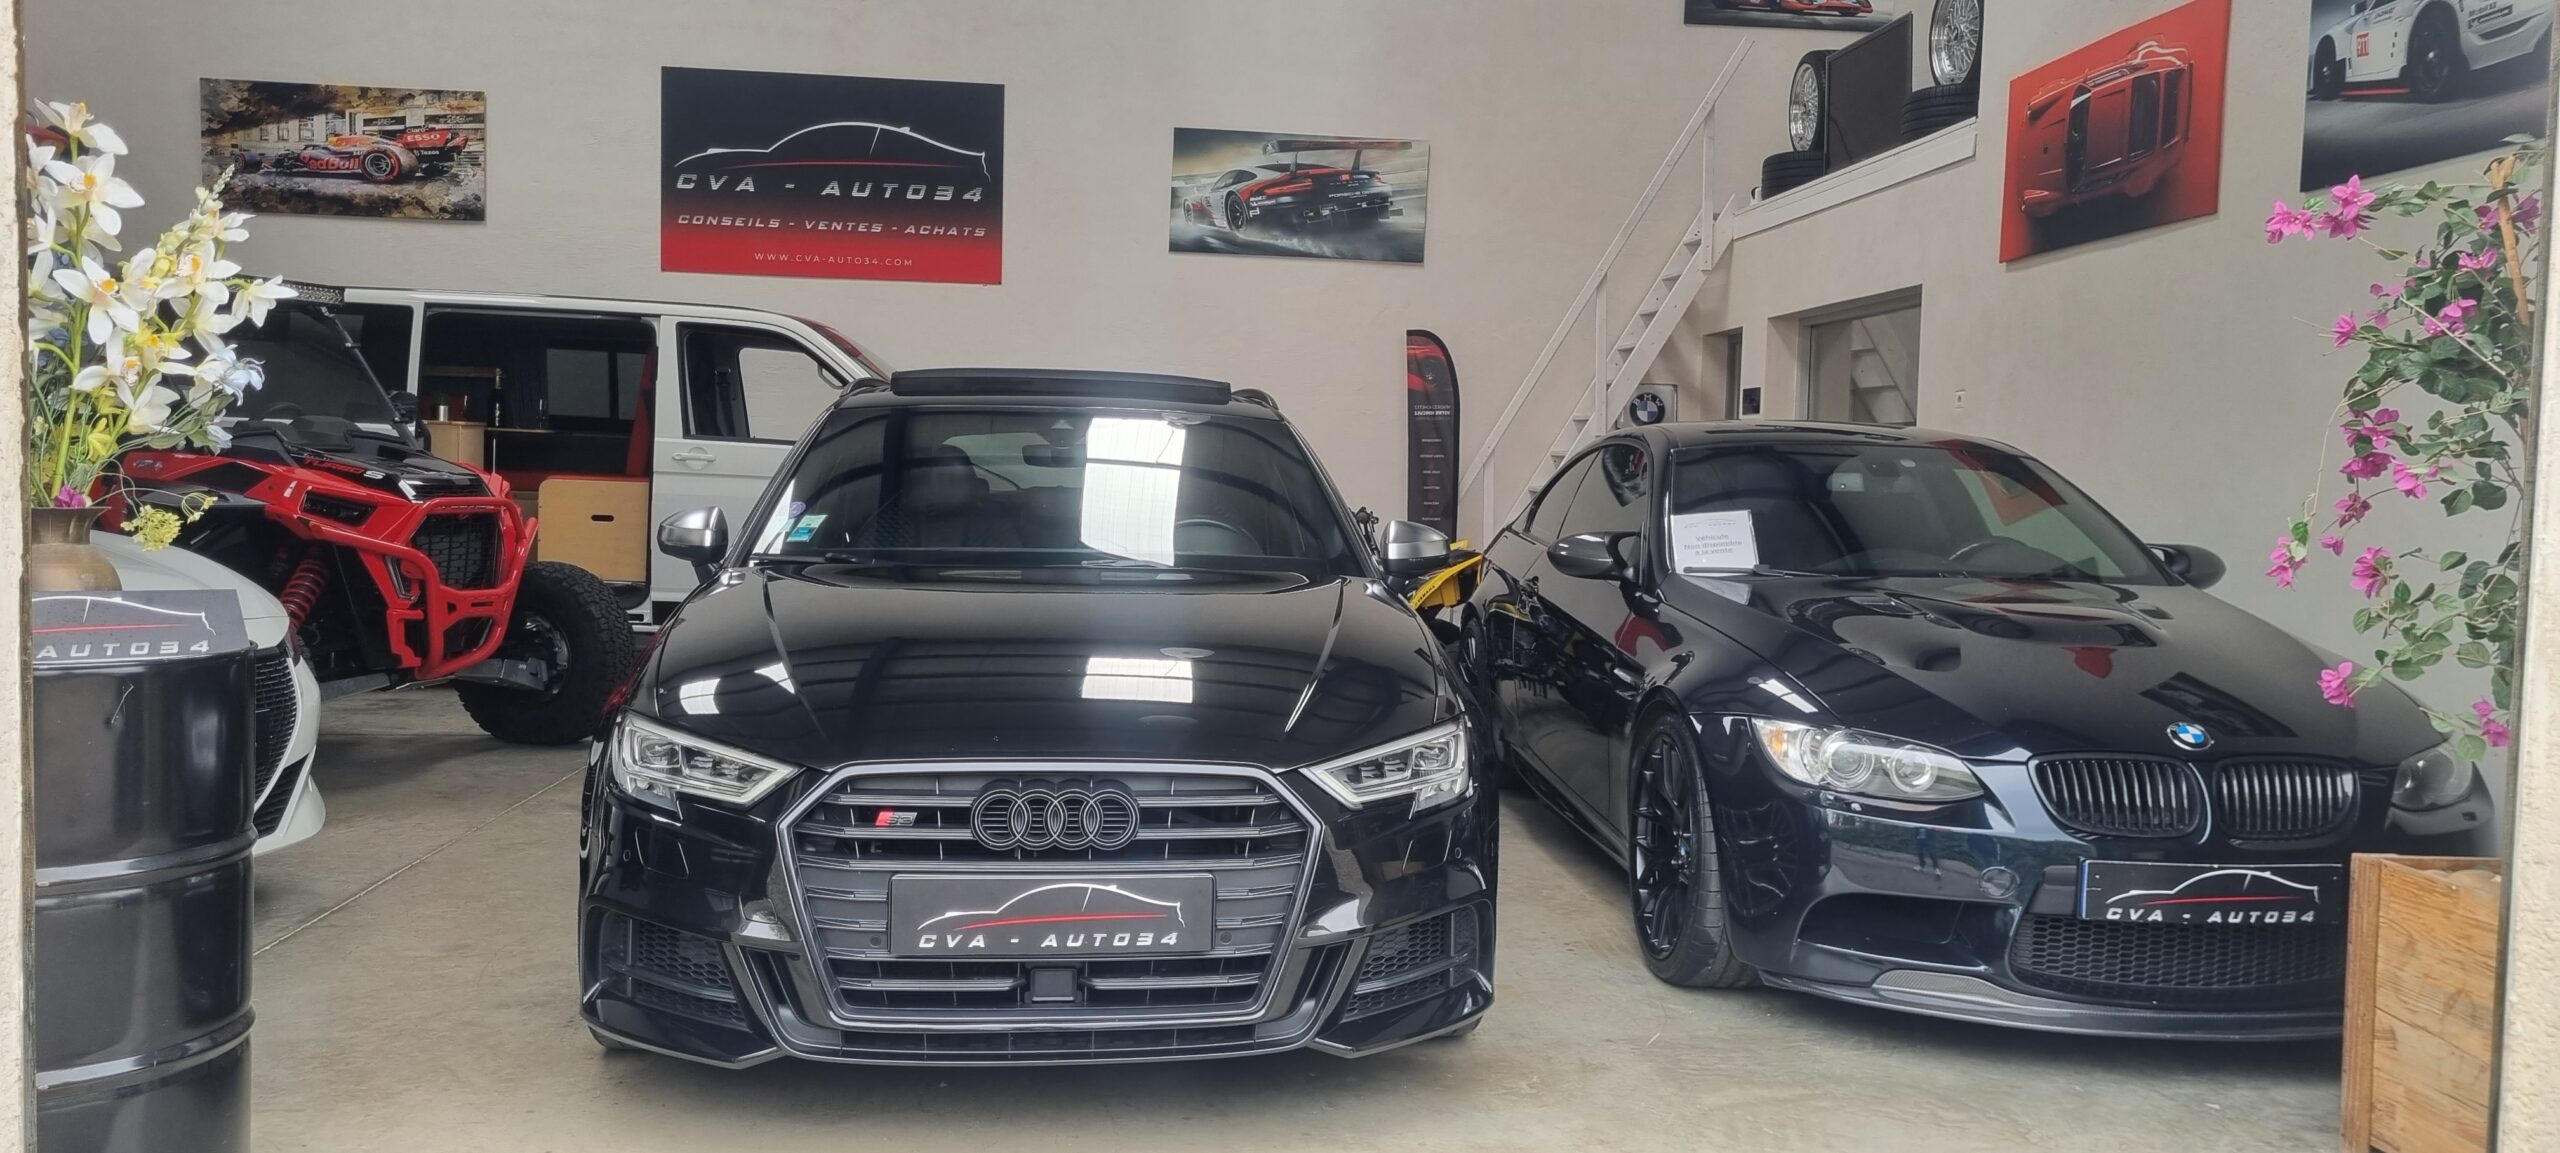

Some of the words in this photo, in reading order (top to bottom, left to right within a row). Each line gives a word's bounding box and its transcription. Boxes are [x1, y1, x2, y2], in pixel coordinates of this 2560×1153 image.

[676, 174, 755, 192] CVA
[821, 181, 983, 202] AUTO34
[678, 215, 780, 228] CONSEILS
[805, 220, 883, 232] VENTES
[904, 225, 987, 237] ACHATS
[754, 252, 913, 266] WWW.CVA-AUTO34.COM
[1632, 393, 1664, 407] BMW
[303, 457, 366, 474] TURBO
[363, 470, 386, 480] S
[36, 640, 211, 658] AUTO34
[2105, 908, 2163, 921] CVA
[2206, 911, 2315, 923] AUTO34
[918, 934, 986, 948] CVA
[1040, 932, 1179, 948] AUTO34
